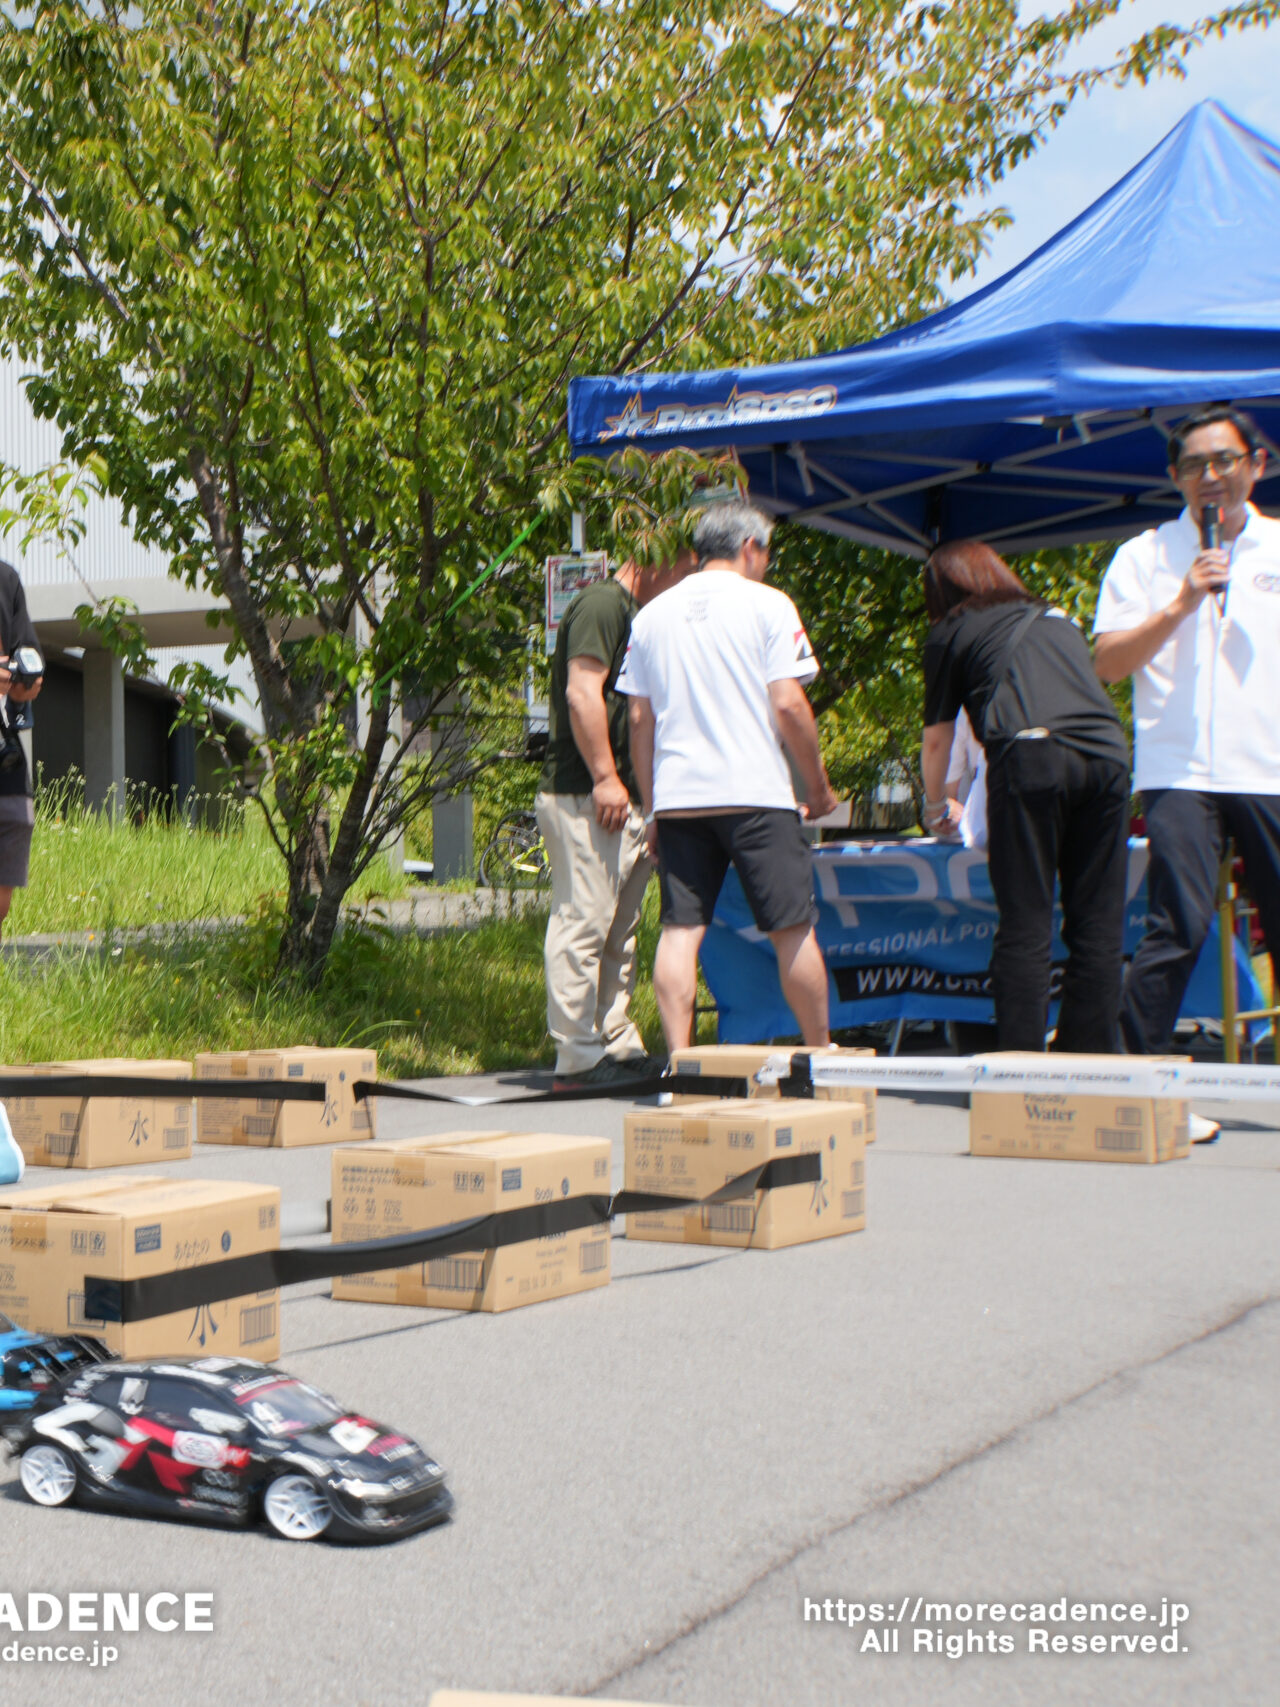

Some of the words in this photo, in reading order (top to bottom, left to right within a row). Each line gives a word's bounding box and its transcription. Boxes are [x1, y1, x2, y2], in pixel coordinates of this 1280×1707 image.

[993, 1071, 1023, 1081] JAPAN
[1027, 1072, 1067, 1082] CYCLING
[1070, 1073, 1131, 1083] FEDERATION
[1185, 1077, 1218, 1087] JAPAN
[1221, 1078, 1261, 1088] CYCLING
[319, 1093, 338, 1128] 水
[1024, 1104, 1077, 1122] Water
[128, 1109, 149, 1148] 水
